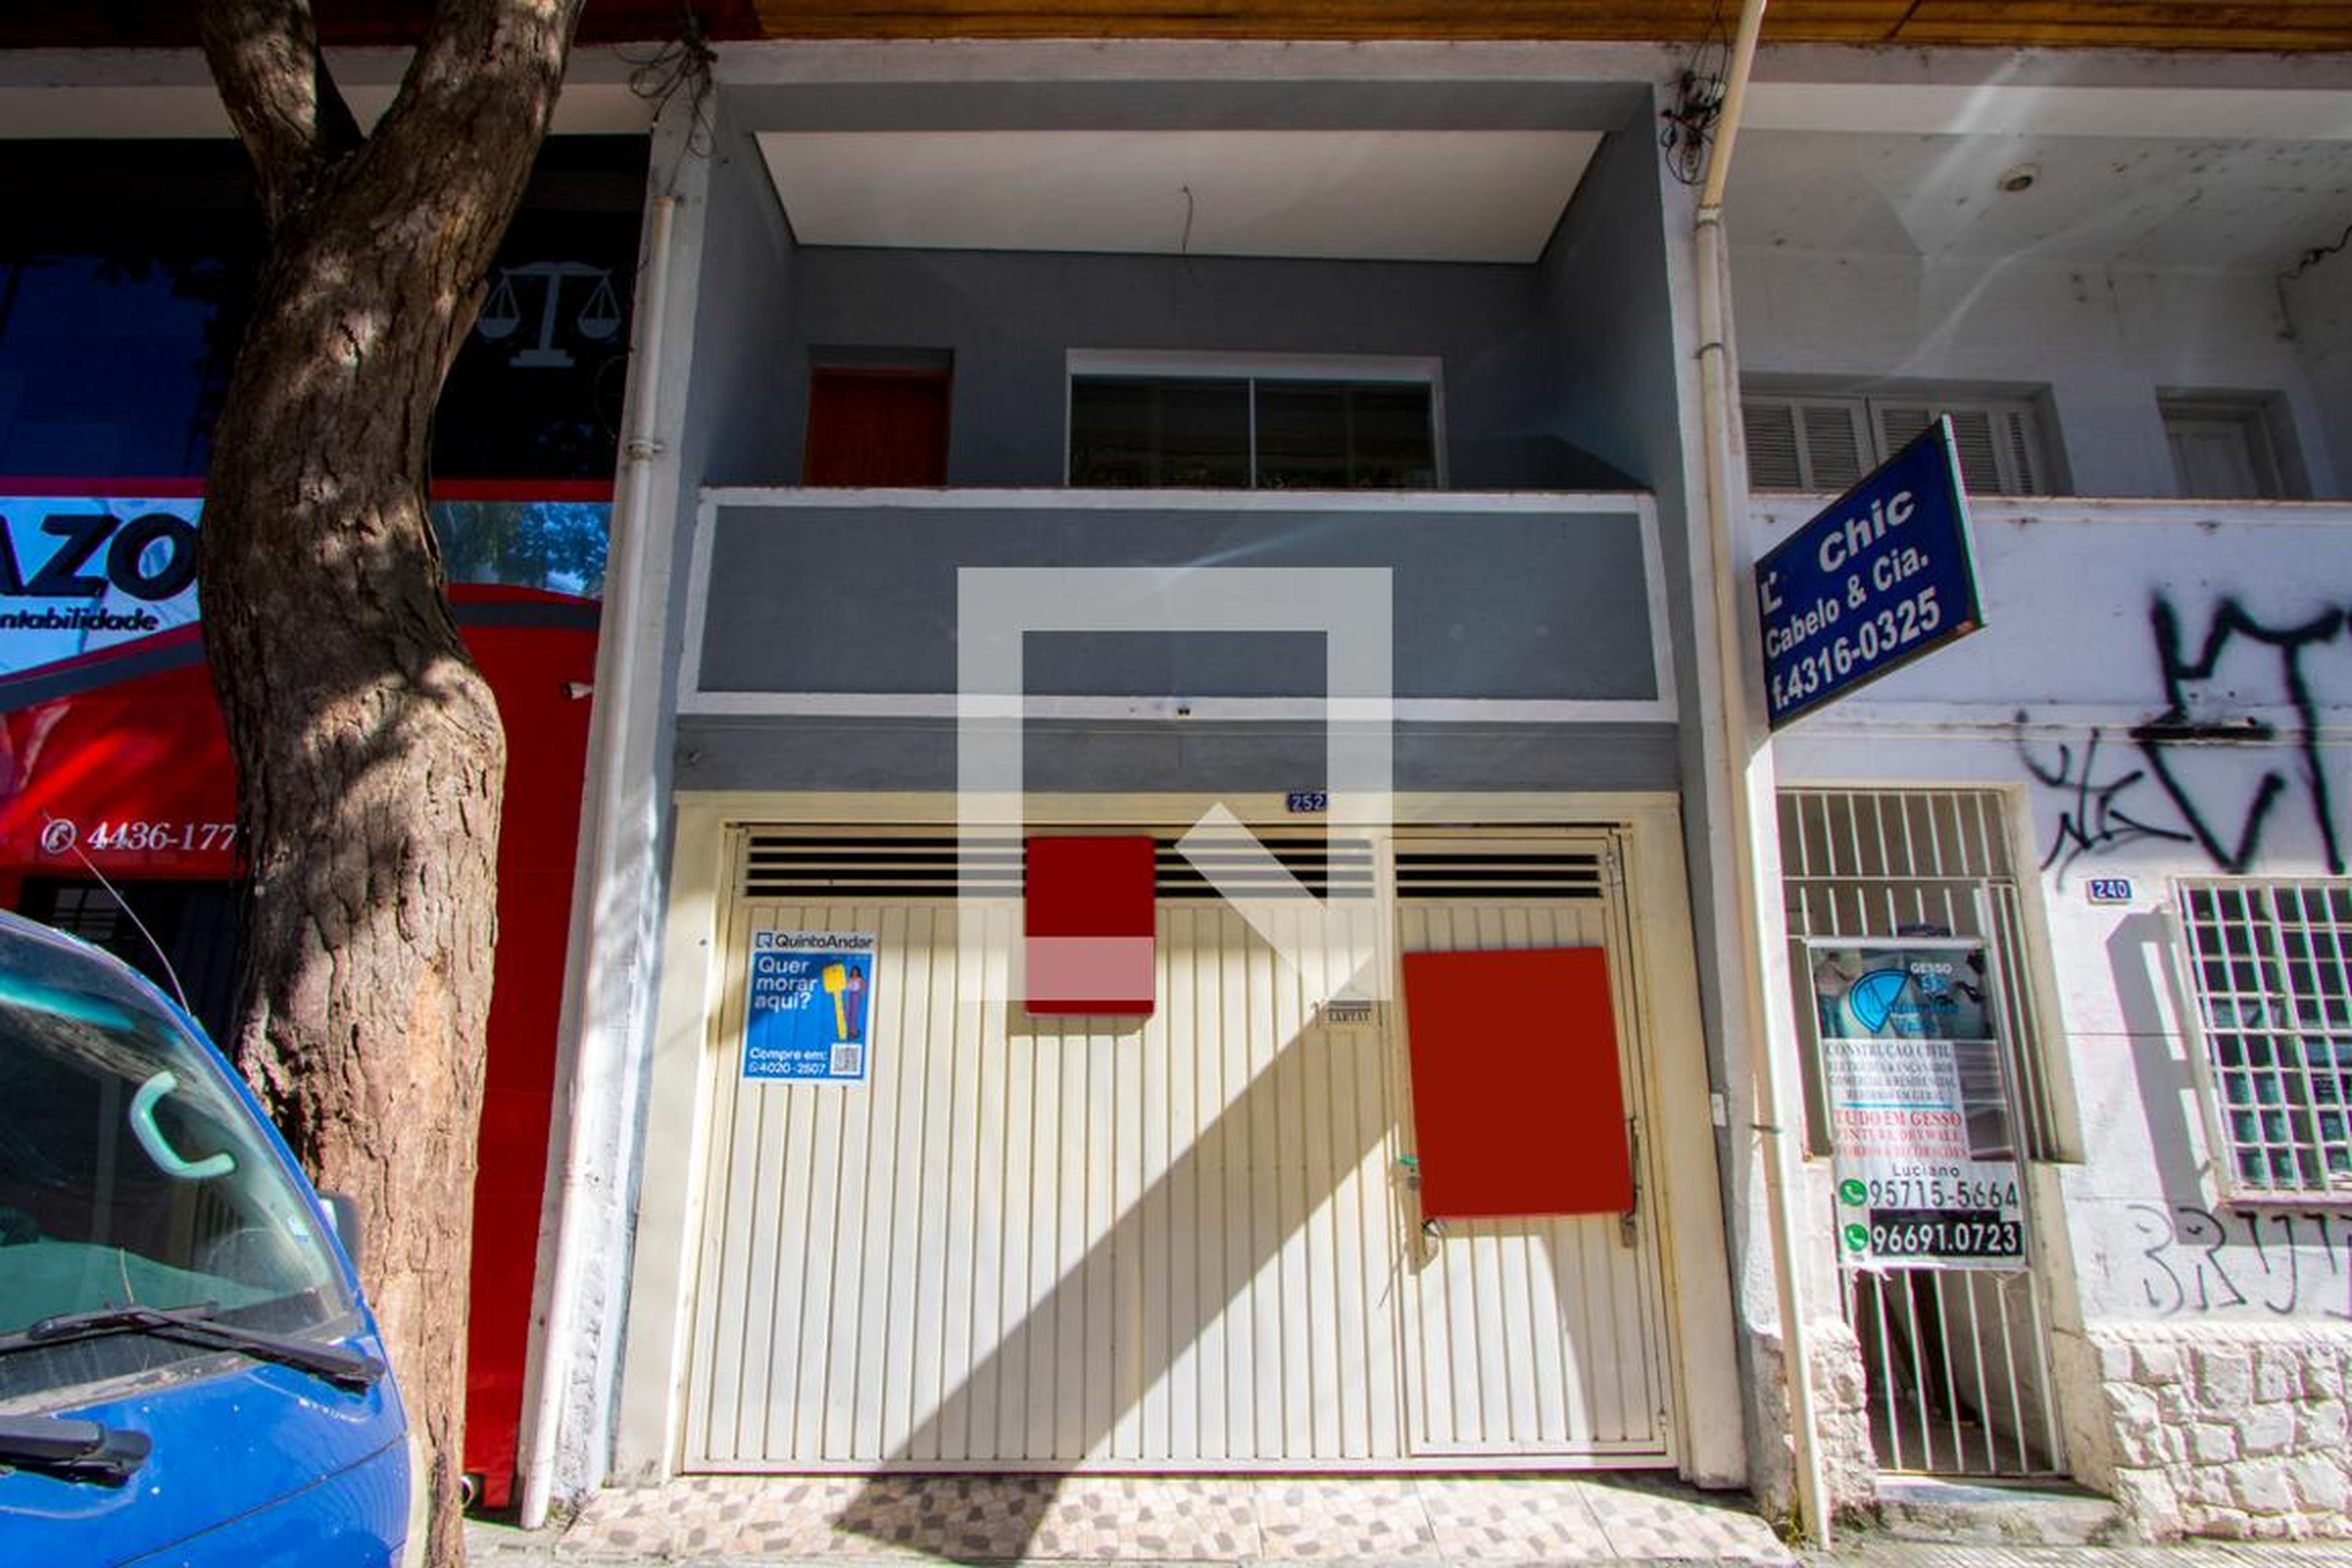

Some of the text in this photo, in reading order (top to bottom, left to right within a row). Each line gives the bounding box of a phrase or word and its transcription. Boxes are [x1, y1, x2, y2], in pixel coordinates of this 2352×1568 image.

[1818, 491, 1917, 573] Chic
[1765, 546, 1929, 659] Cabelo & Cia.
[1291, 794, 1324, 810] 252
[87, 821, 238, 851] 4436-177
[2095, 881, 2128, 897] 240
[775, 933, 874, 949] QuintoAndar
[758, 956, 811, 973] Quer
[756, 977, 818, 992] morar
[753, 992, 812, 1012] aqui?
[749, 1047, 802, 1061] Compre
[1909, 1110, 1962, 1127] GESSO
[1893, 1165, 1961, 1177] Luciano
[1869, 1180, 2019, 1208] 95715-5664
[1872, 1223, 2018, 1252] 96691.0723
